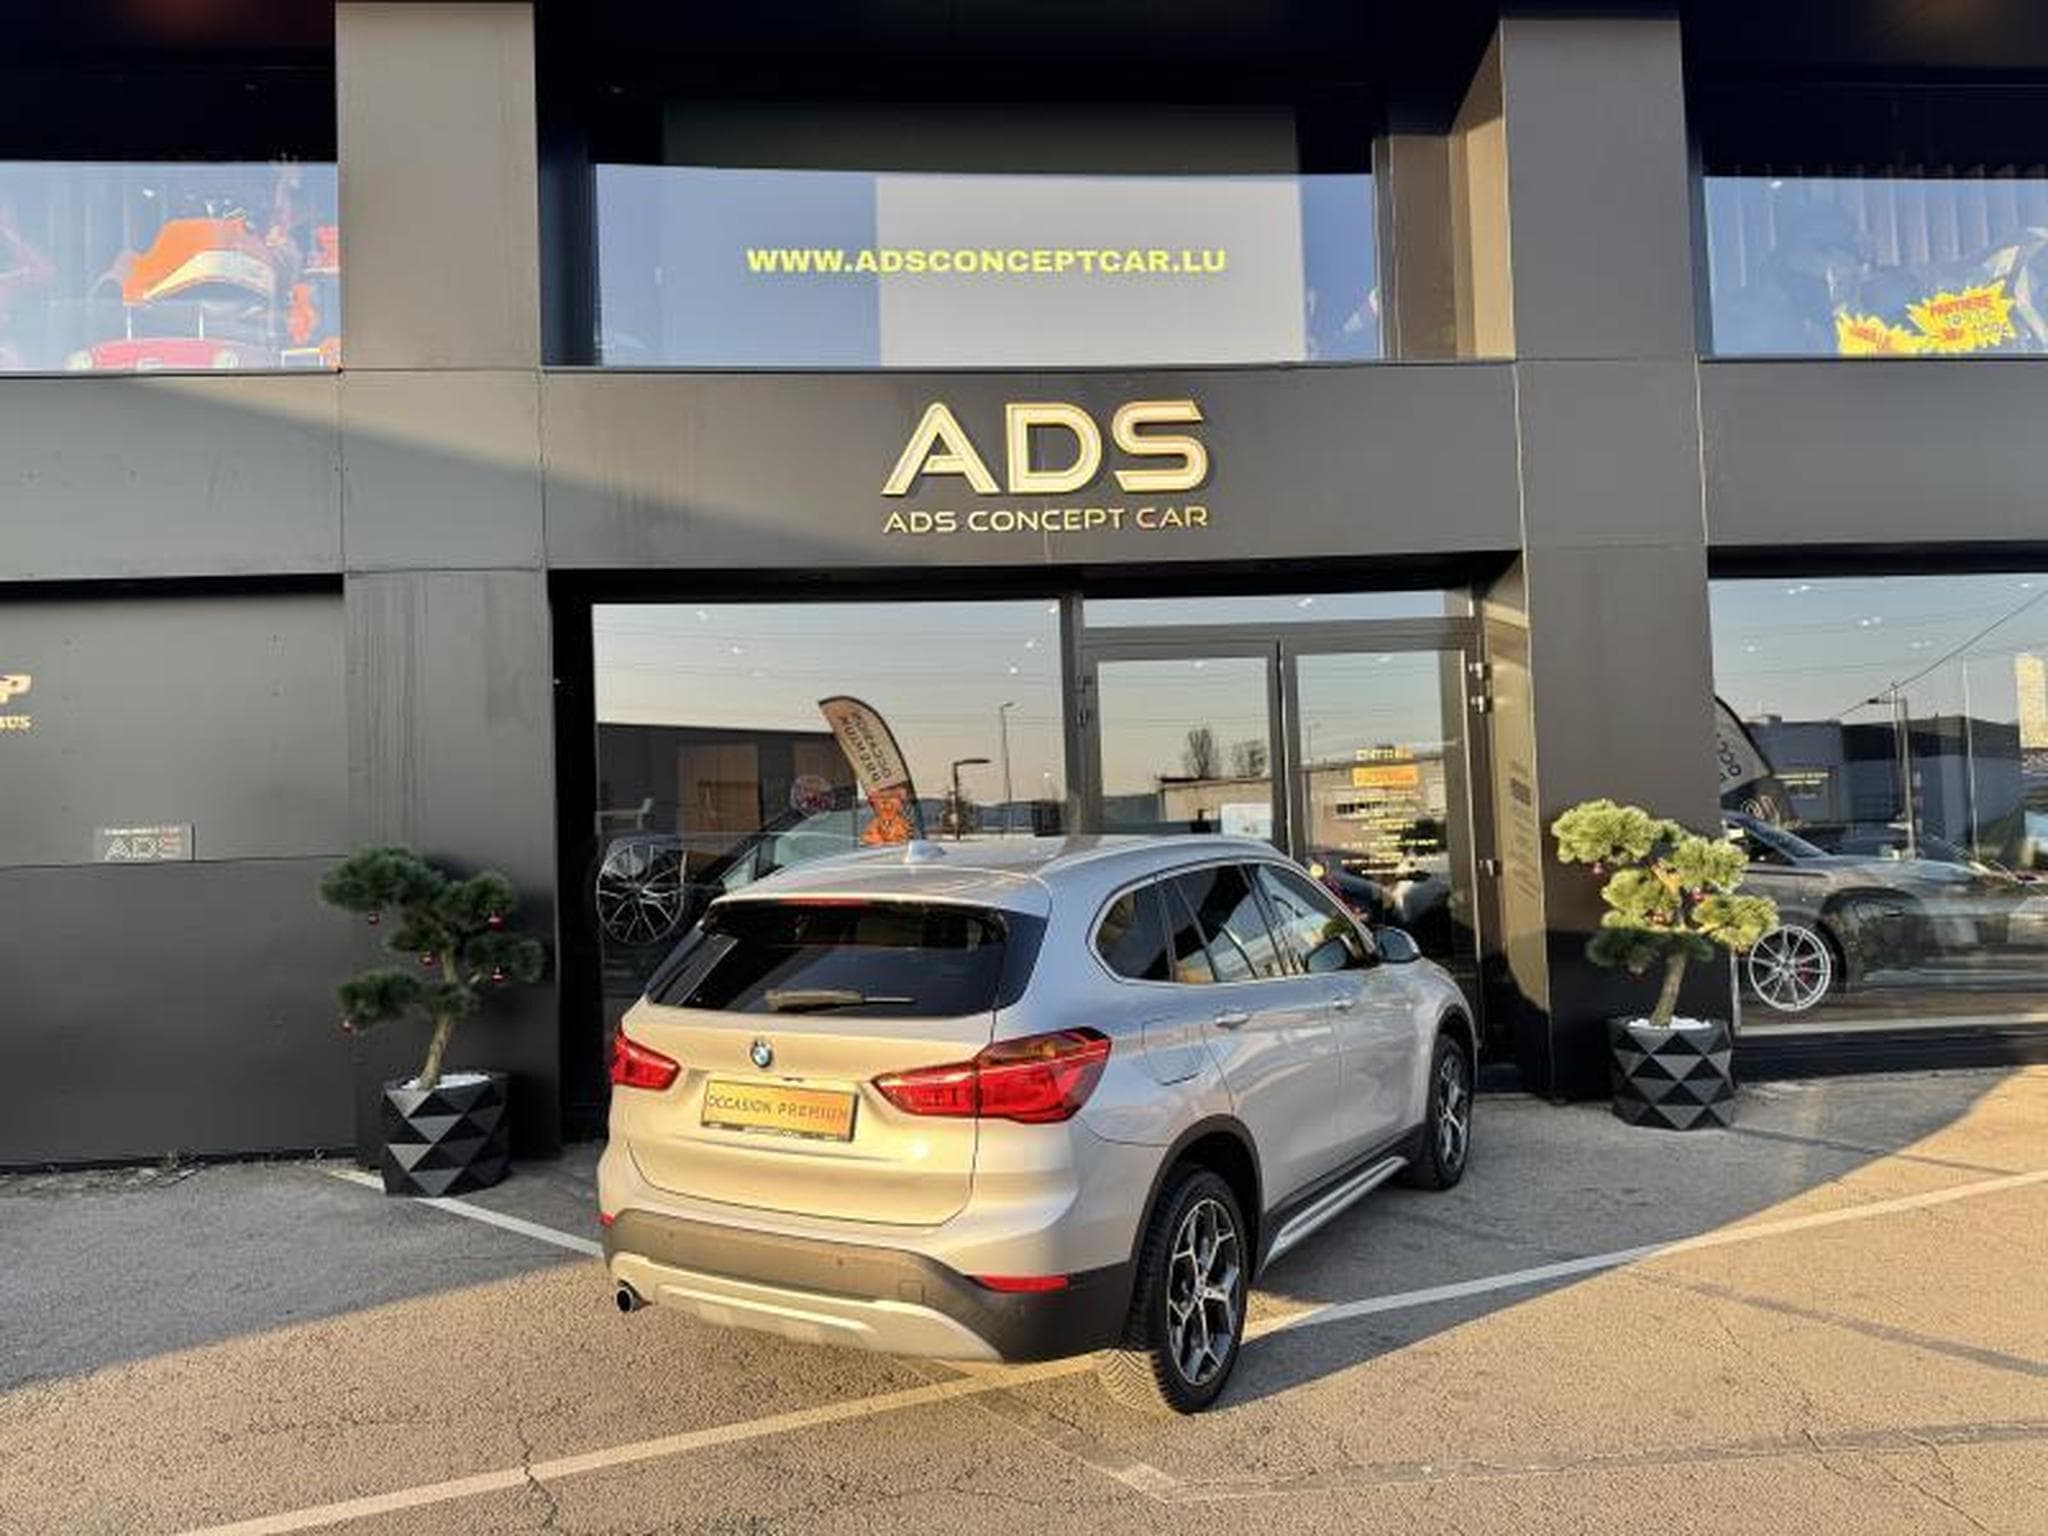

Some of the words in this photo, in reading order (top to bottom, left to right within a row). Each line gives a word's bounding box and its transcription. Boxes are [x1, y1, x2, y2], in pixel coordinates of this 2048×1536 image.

[746, 249, 1227, 273] WWW.ADSCONCEPTCAR.LU
[881, 400, 1208, 496] ADS
[883, 510, 957, 534] ADS
[968, 508, 1126, 532] CONCEPT
[1135, 506, 1208, 529] CAR
[708, 1094, 772, 1115] OCCASION
[777, 1101, 848, 1122] PREMIUM
